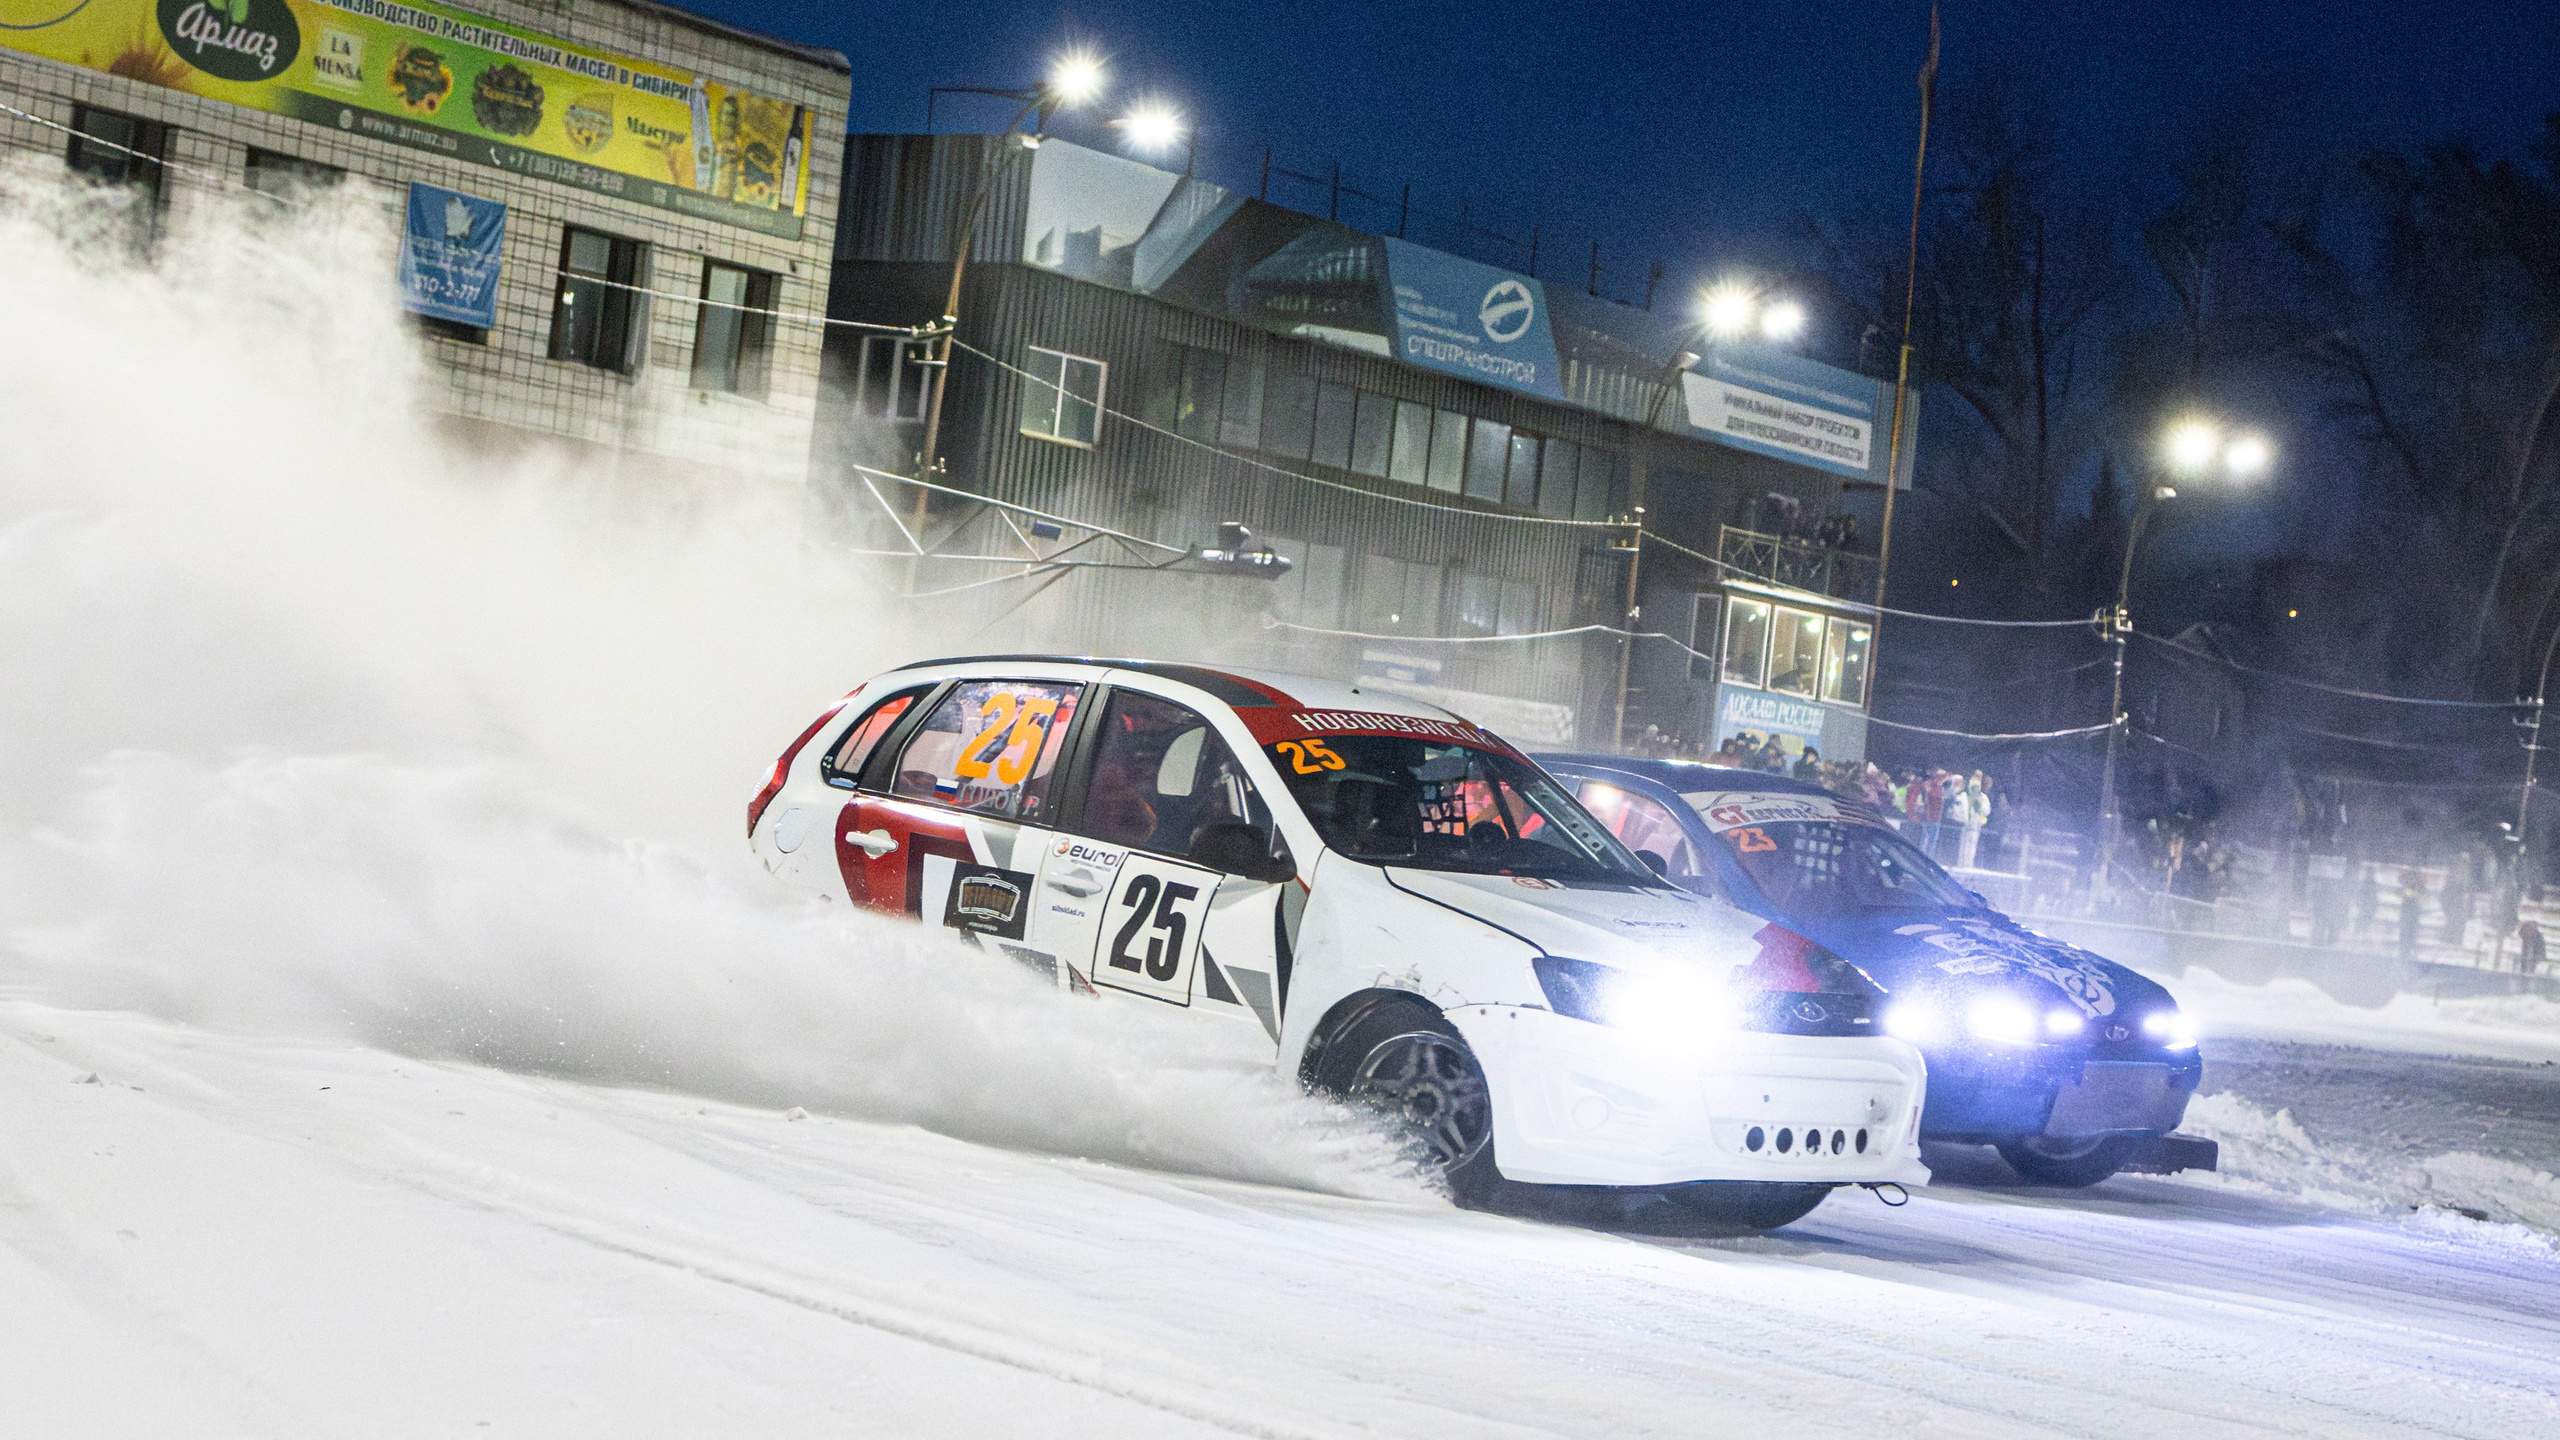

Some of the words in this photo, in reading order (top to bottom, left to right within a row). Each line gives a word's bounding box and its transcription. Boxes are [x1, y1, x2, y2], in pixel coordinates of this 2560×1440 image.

[175, 2, 279, 71] Армаз
[332, 36, 350, 56] LA
[442, 18, 561, 67] РАСТИТЕЛЬНЫХ
[565, 54, 616, 80] МАСЕЛ
[619, 68, 630, 84] В
[632, 72, 692, 102] СИБИРИ
[954, 692, 1060, 786] 25
[1276, 738, 1347, 775] 25
[1069, 845, 1126, 868] eurol
[1109, 873, 1200, 982] 25
